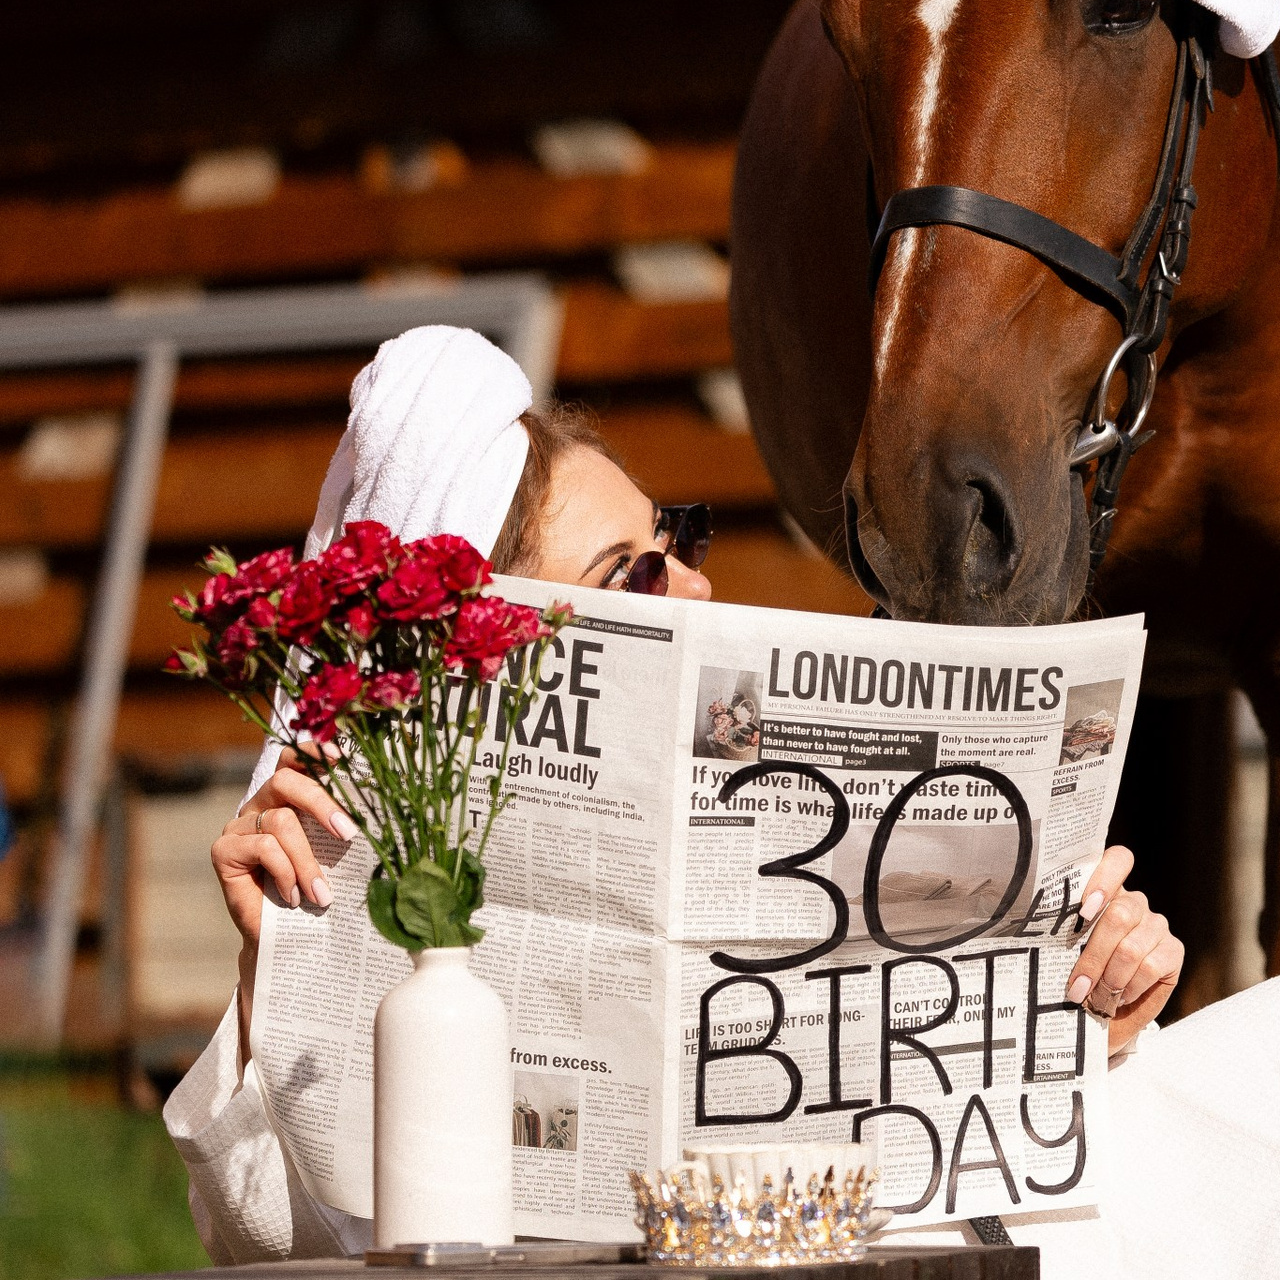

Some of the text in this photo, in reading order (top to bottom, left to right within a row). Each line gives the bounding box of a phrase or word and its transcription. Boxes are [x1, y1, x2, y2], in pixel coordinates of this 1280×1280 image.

[592, 622, 604, 630] AND
[605, 624, 616, 632] LIFE
[617, 625, 631, 633] HATH
[768, 647, 1063, 711] LONDONTIMES
[779, 703, 815, 712] PERSONAL
[816, 706, 844, 715] FAILURE
[845, 708, 858, 716] HAS
[859, 710, 878, 718] ONLY
[879, 711, 934, 721] STRENGTHENED
[781, 724, 810, 736] better
[812, 727, 822, 737] to
[824, 728, 847, 739] have
[849, 729, 880, 742] fought
[881, 732, 900, 742] and
[901, 733, 923, 744] lost,
[942, 734, 1049, 745] Only those who capture
[763, 736, 911, 756] than never to have fought at all.
[941, 747, 1036, 757] the moment are real.
[762, 750, 867, 766] INTERNATIONAL page3
[1053, 759, 1105, 776] REFRAIN FROM
[472, 751, 599, 791] Laugh loudly
[1052, 774, 1081, 785] EXCESS.
[692, 765, 707, 784] If
[711, 770, 745, 789] yo
[752, 770, 791, 789] love
[902, 780, 960, 797] aste
[966, 781, 1010, 797] tim
[1052, 786, 1073, 795] SPORTS
[469, 775, 488, 785] With
[504, 782, 560, 799] entrenchment
[562, 791, 570, 799] of
[571, 794, 620, 809] colonialism,
[622, 802, 636, 810] the
[469, 796, 484, 805] was
[469, 786, 645, 822] contrutin made by others, including India,
[691, 792, 998, 823] for time is wha life made up
[1041, 863, 1076, 885] ONLY THOSE
[1052, 881, 1080, 897] MOENT
[933, 993, 989, 1010] COTRO
[685, 1010, 865, 1040] LIF IS TOO SHRT FOR NG-
[926, 1011, 960, 1026] FR,
[964, 1009, 991, 1023] ONL
[997, 1006, 1016, 1019] MY
[684, 1035, 786, 1056] TEM GRUDS.
[696, 947, 1085, 1127] BIRTH
[510, 1047, 612, 1073] from excess.
[887, 1052, 928, 1060] NTERNATIO
[1022, 1053, 1055, 1062] RRAIN
[1022, 1063, 1053, 1073] ESS.
[1026, 1073, 1069, 1082] ERTAINMENT
[853, 1090, 1087, 1214] DAY
